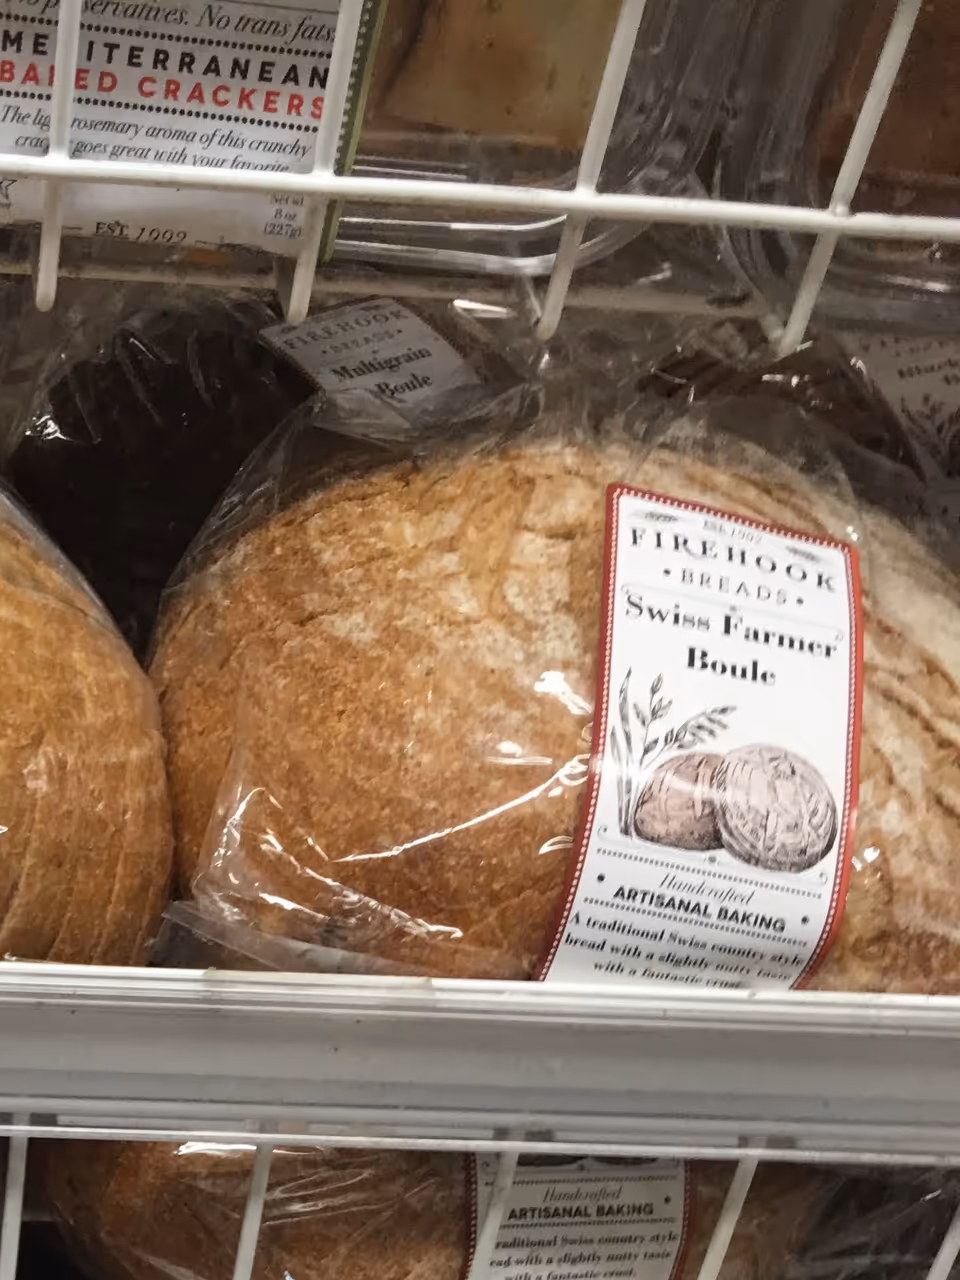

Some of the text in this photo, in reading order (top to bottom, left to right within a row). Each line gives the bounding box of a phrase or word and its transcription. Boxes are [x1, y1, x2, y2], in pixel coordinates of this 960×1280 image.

[1, 29, 329, 90] MEITERRANEAN
[0, 60, 325, 120] BAED CRACKERS
[0, 104, 31, 126] The
[145, 124, 197, 143] aroma
[198, 128, 221, 150] of
[218, 130, 246, 149] this
[248, 138, 313, 159] crunchy
[153, 147, 188, 165] with
[331, 346, 434, 383] Multigrain
[375, 373, 434, 399] Boule
[629, 527, 836, 594] FIREHOOK
[681, 567, 789, 606] BREADS
[625, 591, 838, 658] Swiss Farmer
[687, 646, 777, 686] Boule
[586, 915, 666, 942] traditional
[612, 885, 786, 933] ARTISANAL BAKING
[507, 1202, 654, 1221] ARTISANAL BAKING
[495, 1236, 558, 1250] raditional
